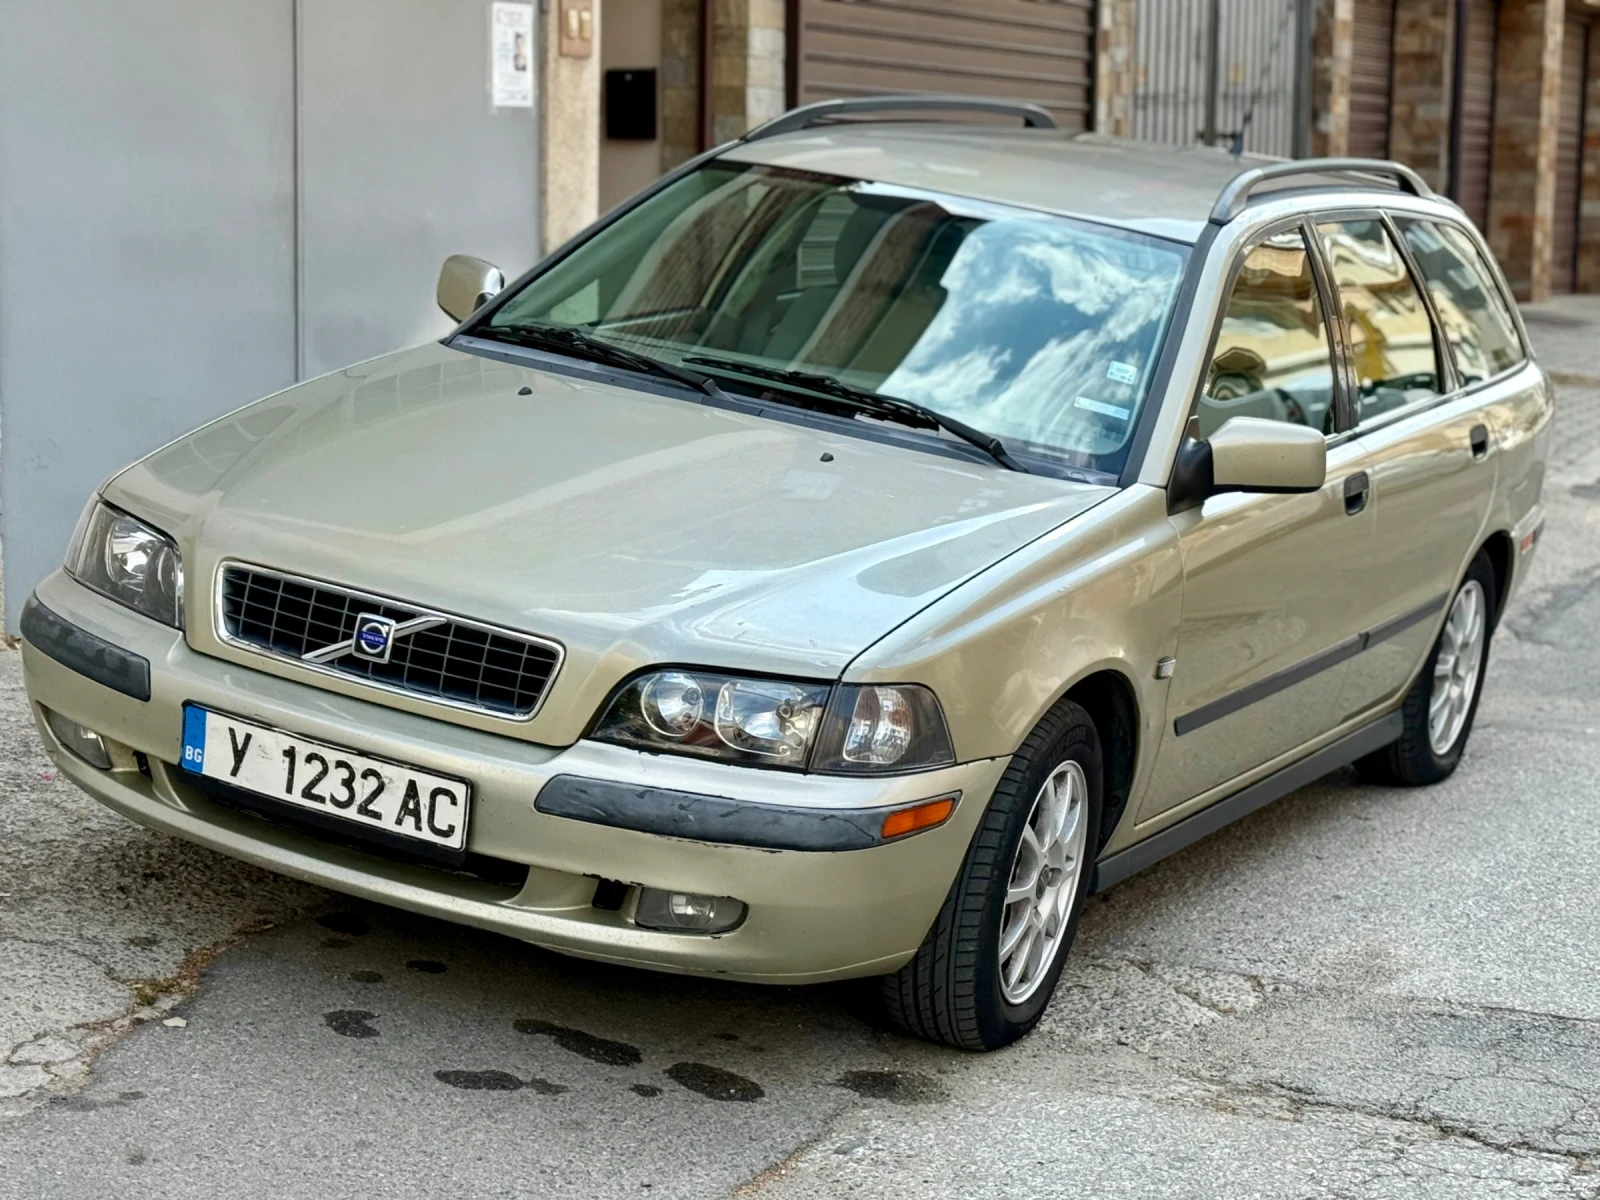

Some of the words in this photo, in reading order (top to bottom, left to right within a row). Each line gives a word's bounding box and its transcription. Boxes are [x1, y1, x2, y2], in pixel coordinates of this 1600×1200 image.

[362, 632, 384, 643] VOLVO
[185, 744, 203, 763] BG
[282, 745, 386, 821] 1232
[394, 778, 458, 838] AC
